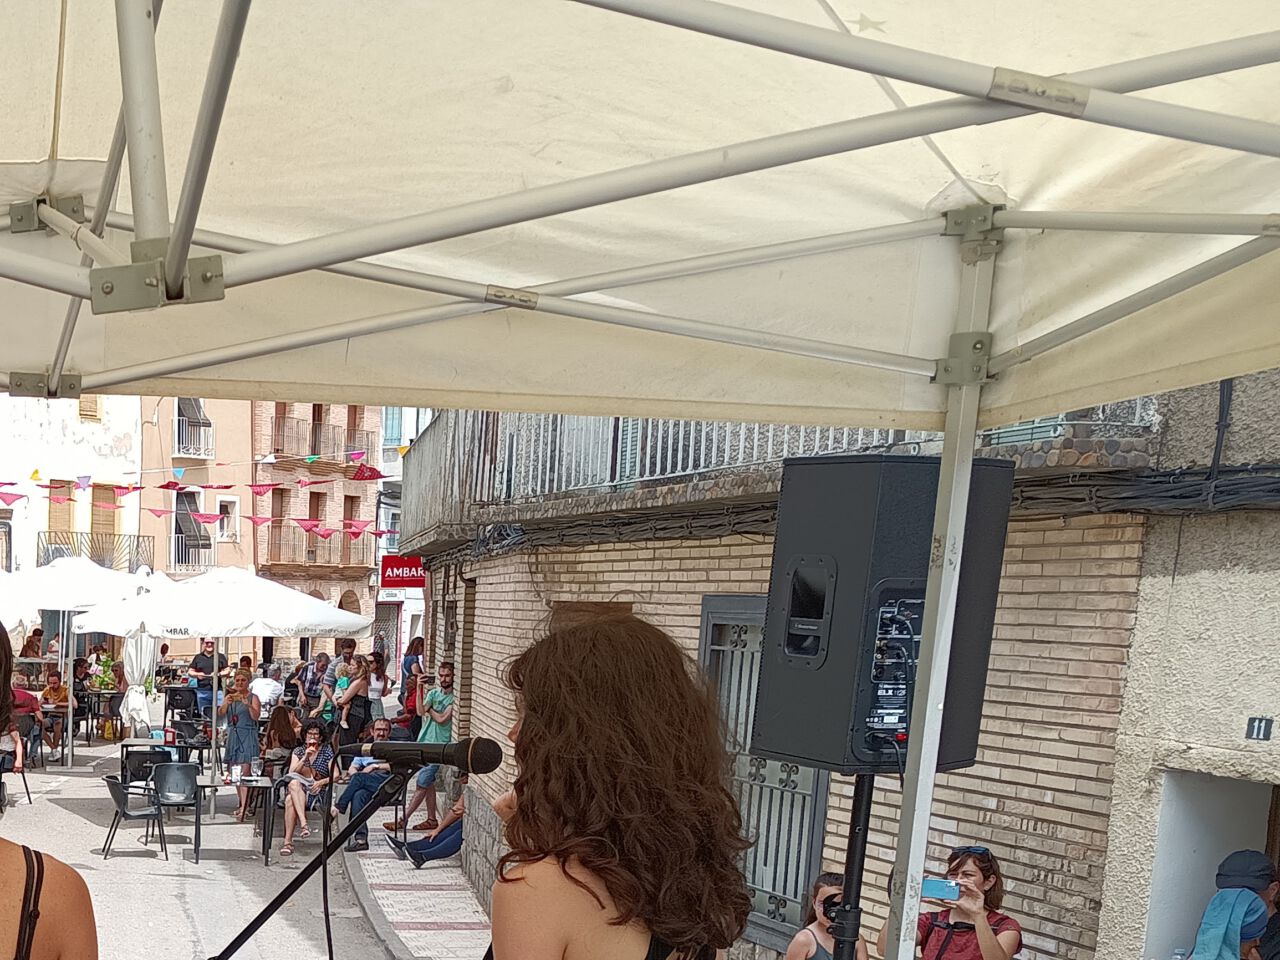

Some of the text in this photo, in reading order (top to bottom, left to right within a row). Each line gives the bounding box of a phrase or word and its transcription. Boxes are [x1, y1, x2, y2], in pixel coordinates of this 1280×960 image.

[384, 567, 426, 577] AMBAR
[162, 627, 190, 636] MBAR
[1251, 719, 1266, 739] 11
